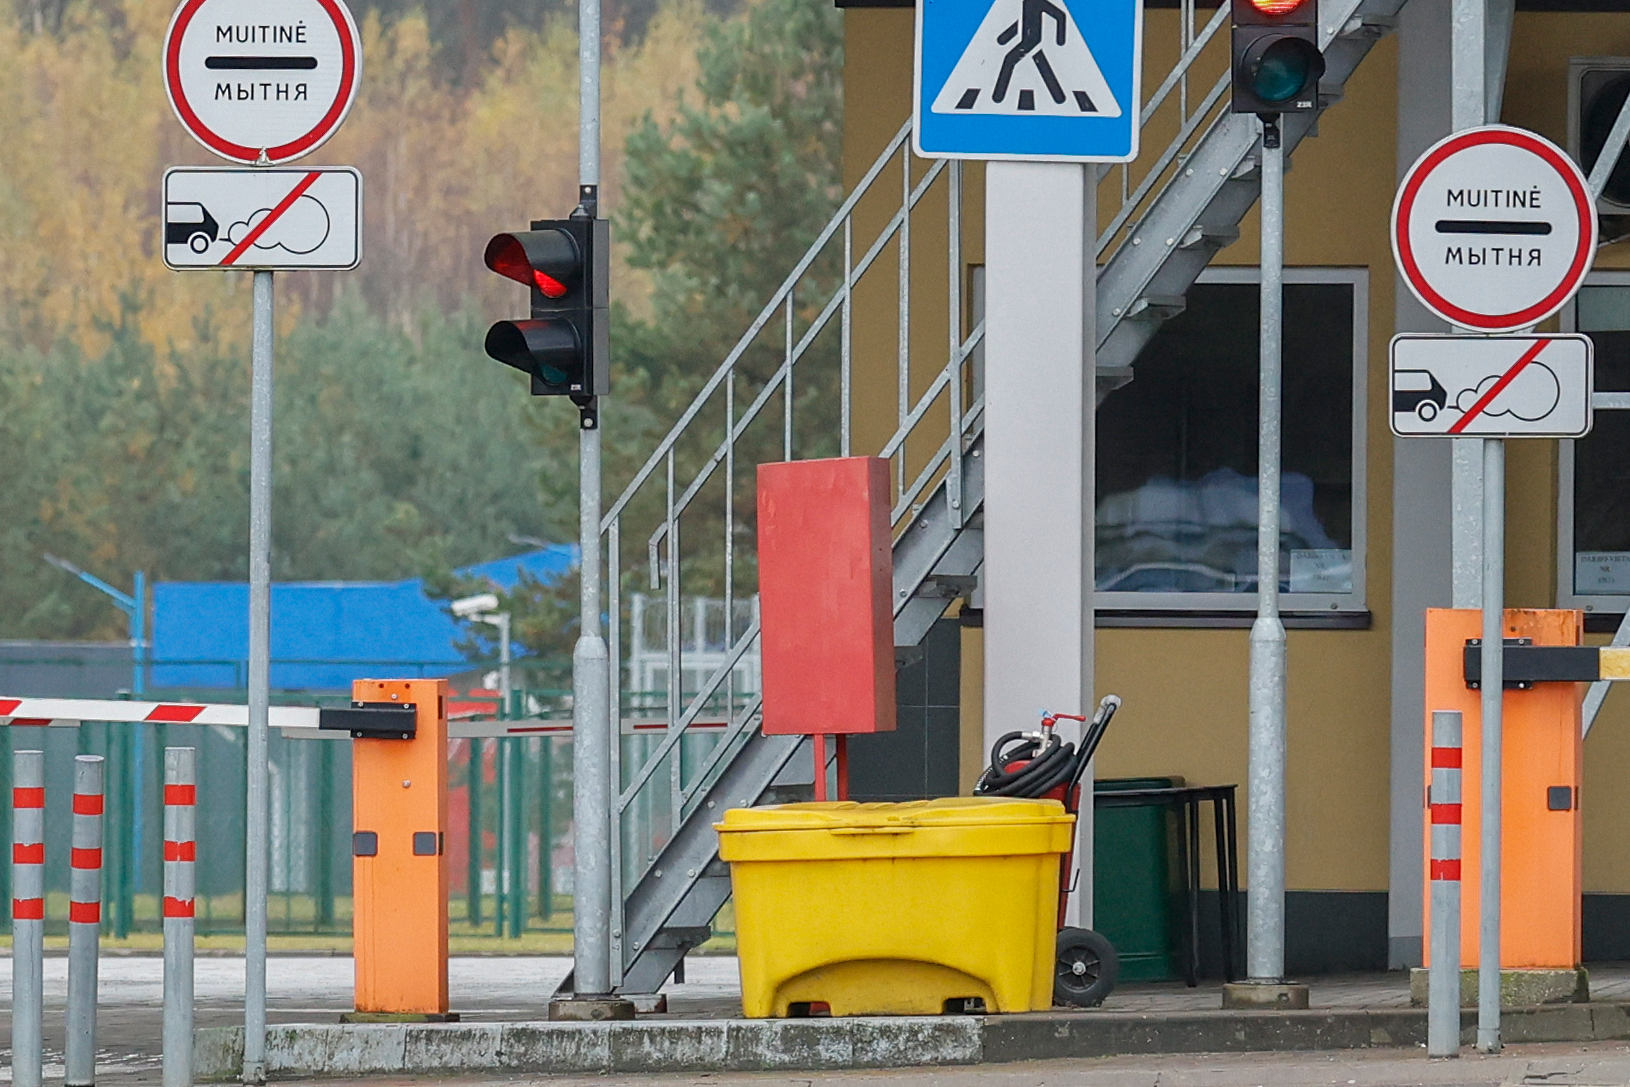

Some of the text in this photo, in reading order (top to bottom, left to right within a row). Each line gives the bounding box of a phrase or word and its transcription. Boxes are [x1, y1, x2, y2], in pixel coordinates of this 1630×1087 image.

[216, 20, 308, 44] MUITINĖ
[214, 82, 309, 102] МЫТНЯ
[1447, 185, 1542, 209] MUITINĖ
[1445, 246, 1542, 267] МЫТНЯ
